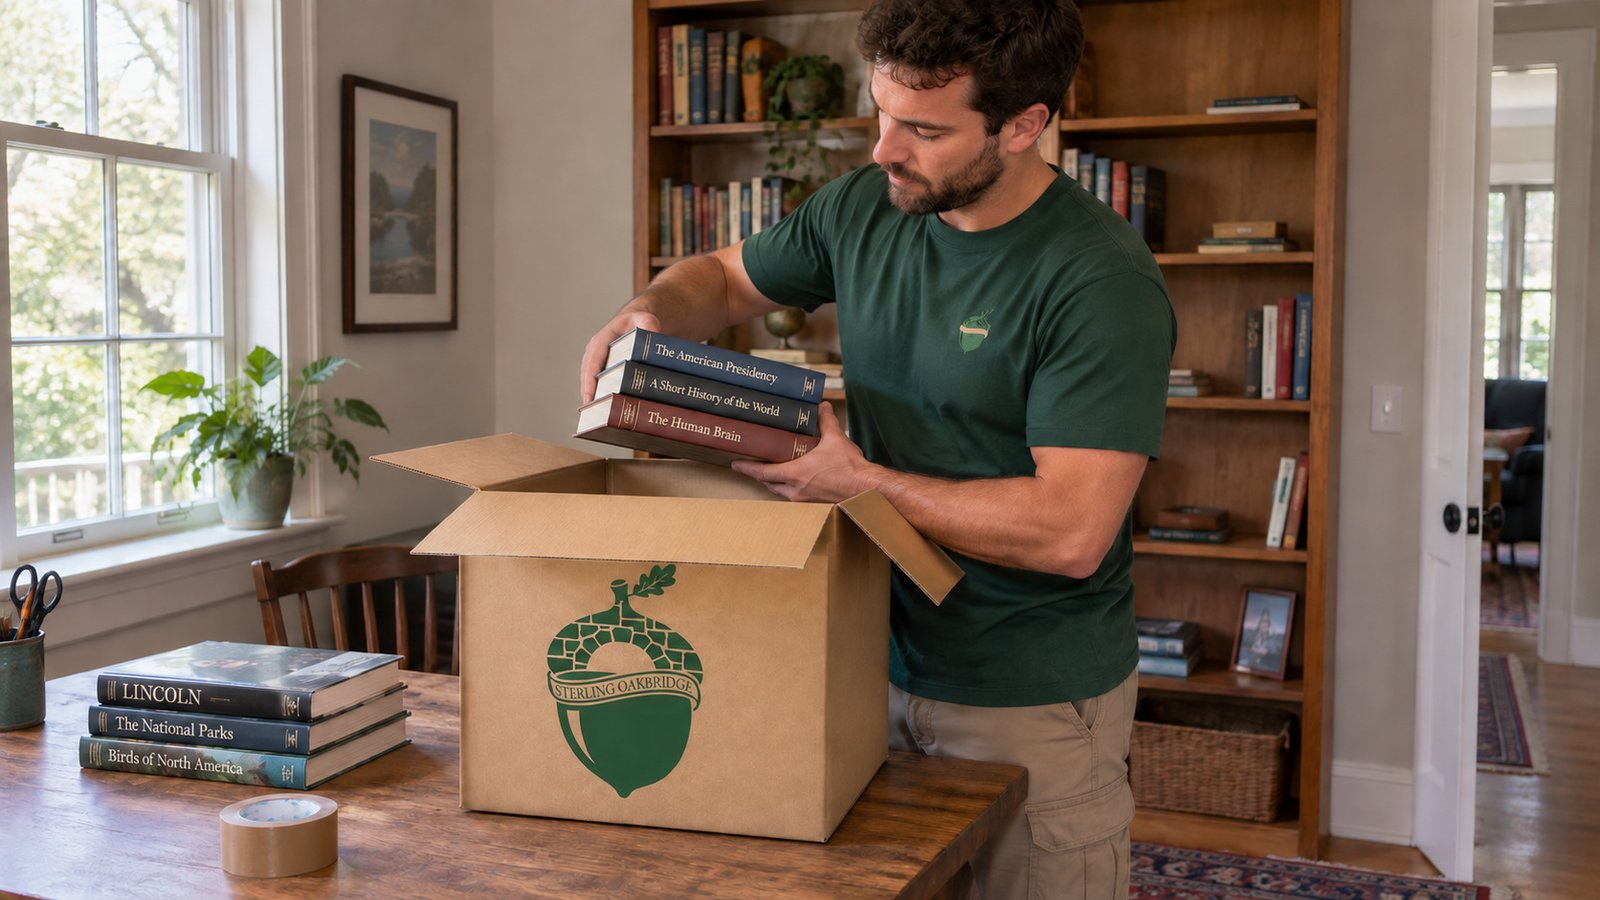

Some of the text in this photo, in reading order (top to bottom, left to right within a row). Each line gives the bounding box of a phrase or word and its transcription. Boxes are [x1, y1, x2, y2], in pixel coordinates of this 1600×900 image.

[655, 343, 778, 385] The American Presidency
[650, 378, 780, 417] A Short History of the World
[648, 410, 742, 443] The Human Brain
[122, 683, 202, 705] LINCOLN
[555, 676, 692, 699] STERLING OAKBRIDGE
[115, 715, 234, 740] The National Parks
[107, 749, 243, 775] Birds of North America
